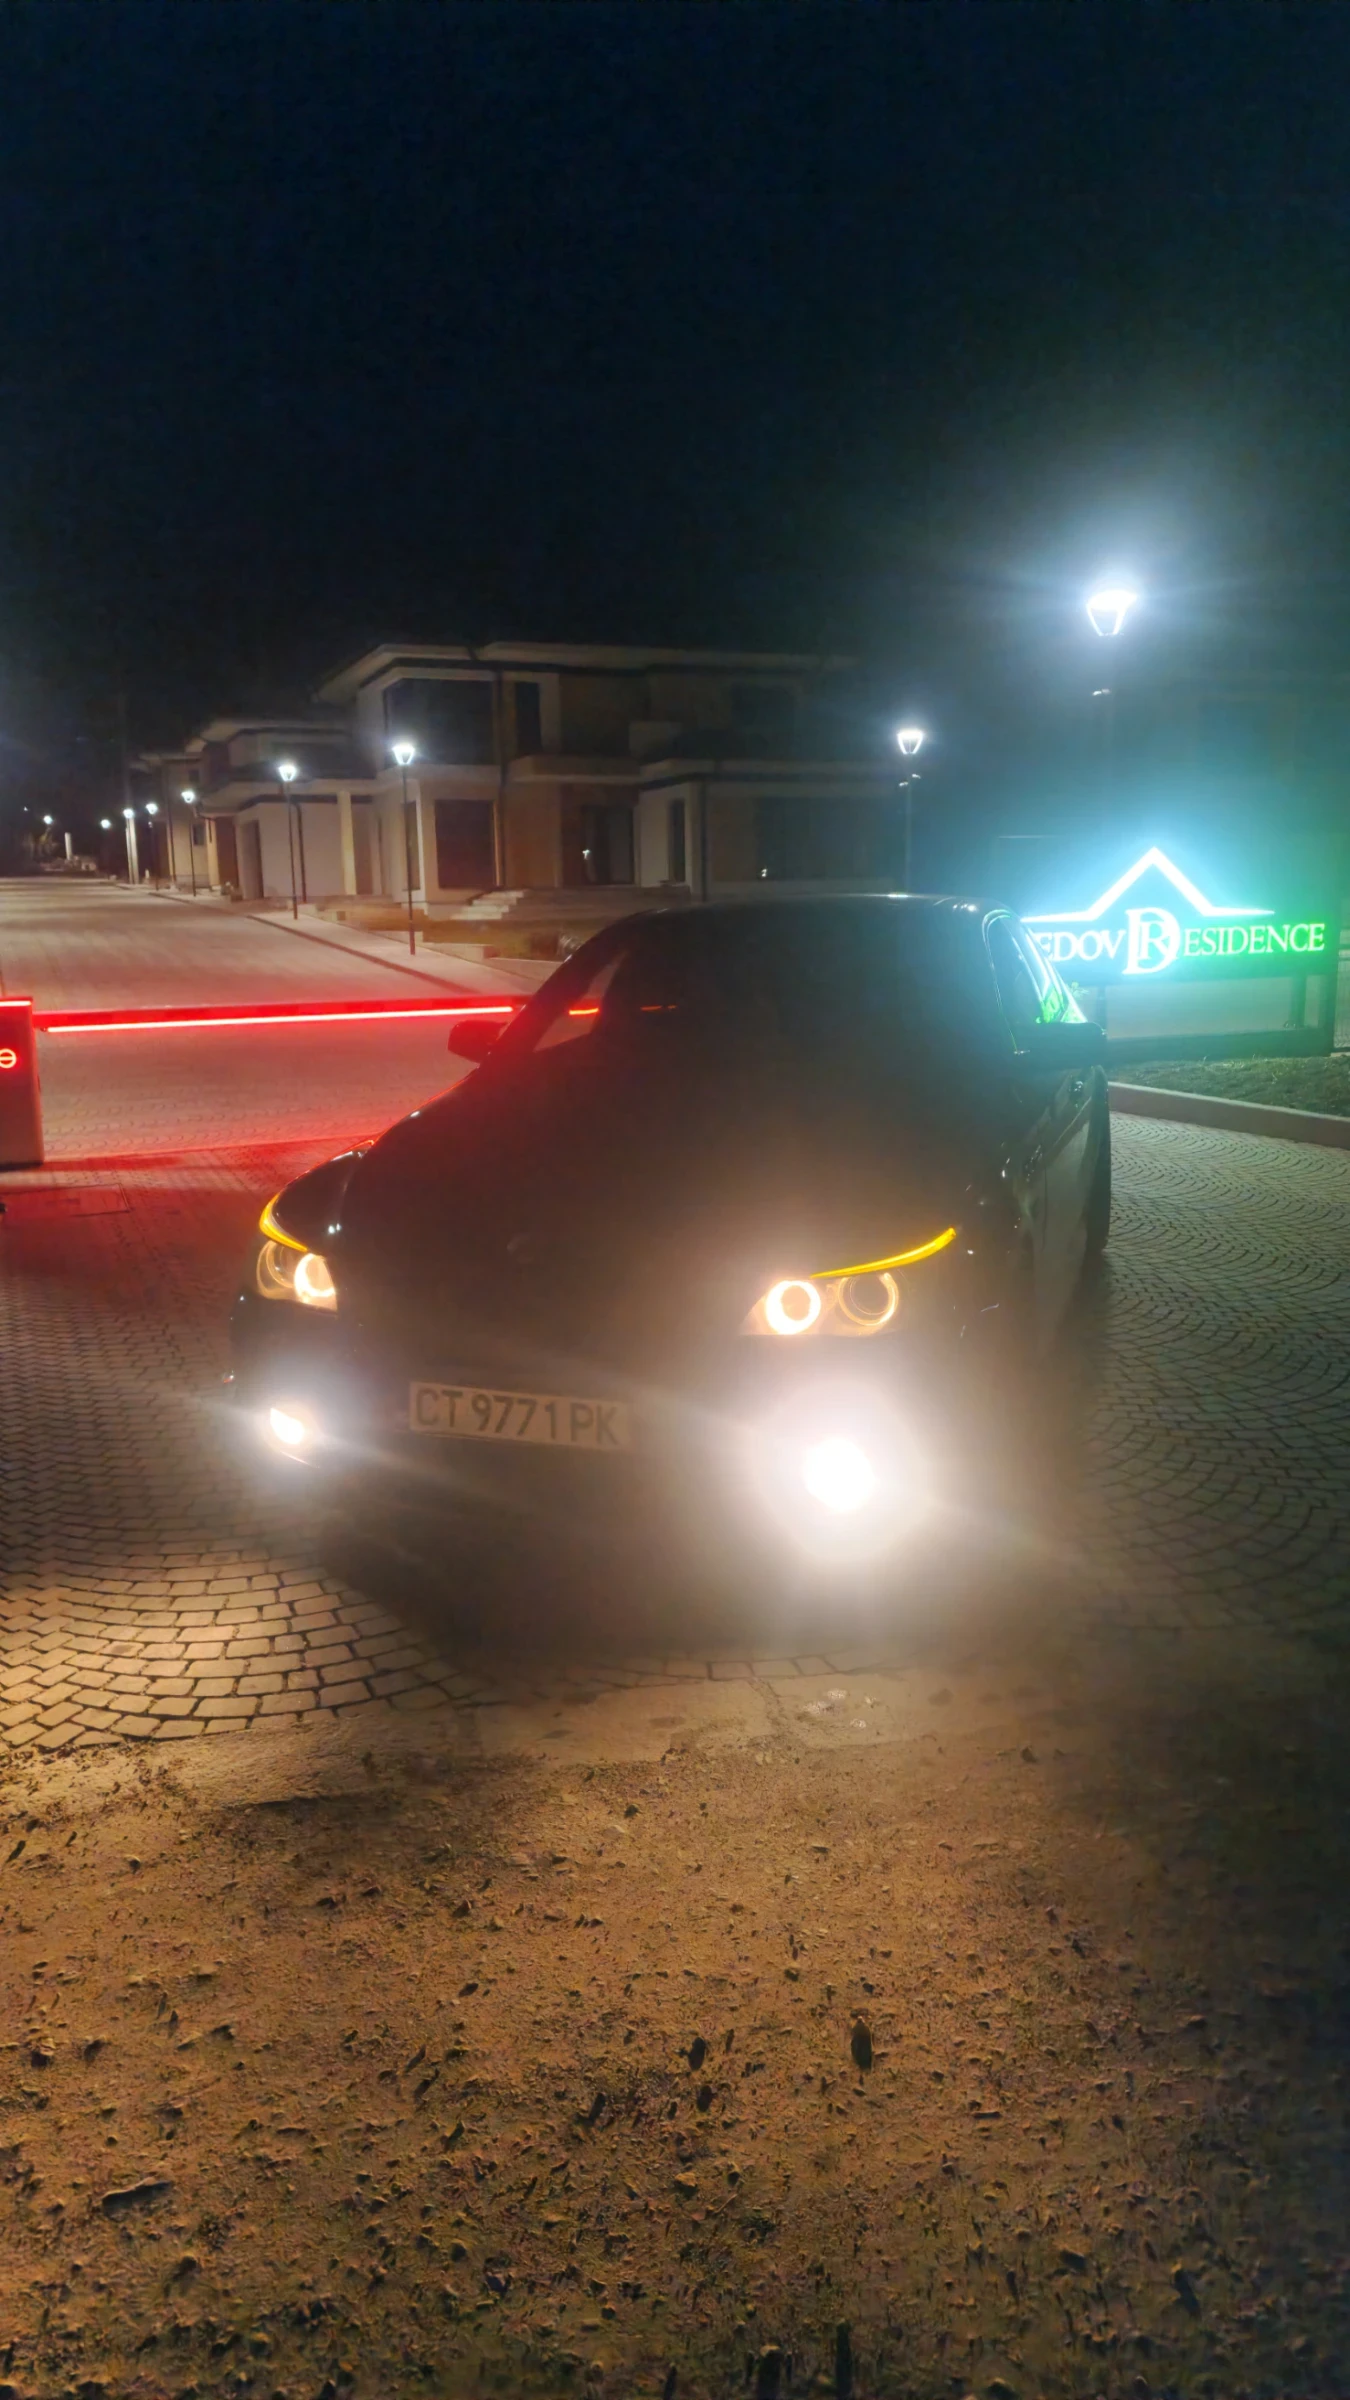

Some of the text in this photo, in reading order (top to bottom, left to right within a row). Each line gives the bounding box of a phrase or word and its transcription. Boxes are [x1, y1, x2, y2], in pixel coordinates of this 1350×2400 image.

[415, 1387, 619, 1446] CT 9771 PK
